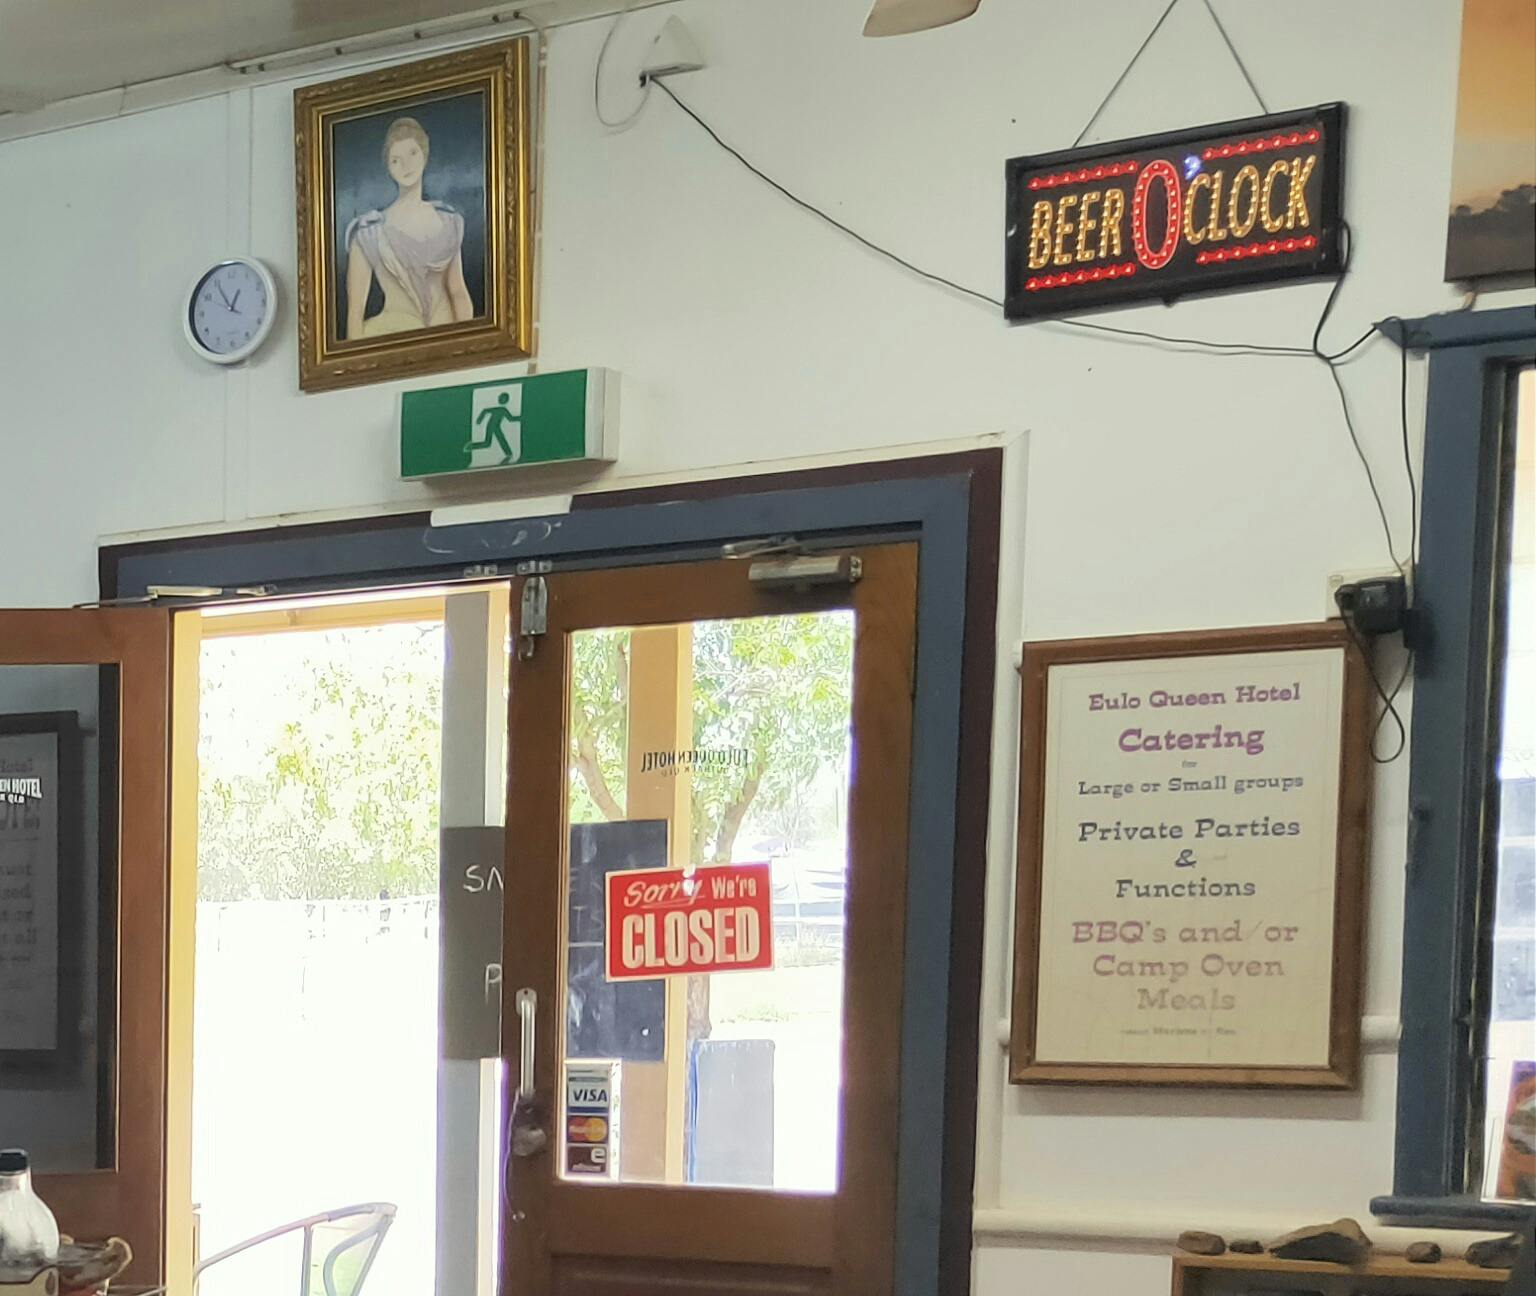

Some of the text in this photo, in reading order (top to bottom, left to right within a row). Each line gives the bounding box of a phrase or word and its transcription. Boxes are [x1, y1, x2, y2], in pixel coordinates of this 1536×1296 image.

[1027, 187, 1126, 270] BEER
[1088, 682, 1301, 712] Eulo Queen Hotel
[1118, 725, 1266, 756] Catering
[1181, 760, 1197, 769] for
[11, 778, 43, 800] HOTEL
[1077, 774, 1304, 799] Large or Small groups
[1077, 816, 1300, 842] Private Parties
[1174, 848, 1197, 869] &
[622, 878, 704, 908] Sorry
[710, 874, 758, 900] We're
[1115, 877, 1257, 899] Functions
[622, 905, 761, 969] CLOSED
[1071, 920, 1167, 944] BBQ's
[1092, 953, 1285, 983] Camp Oven
[1137, 987, 1237, 1012] Meals
[572, 1089, 607, 1102] VISA
